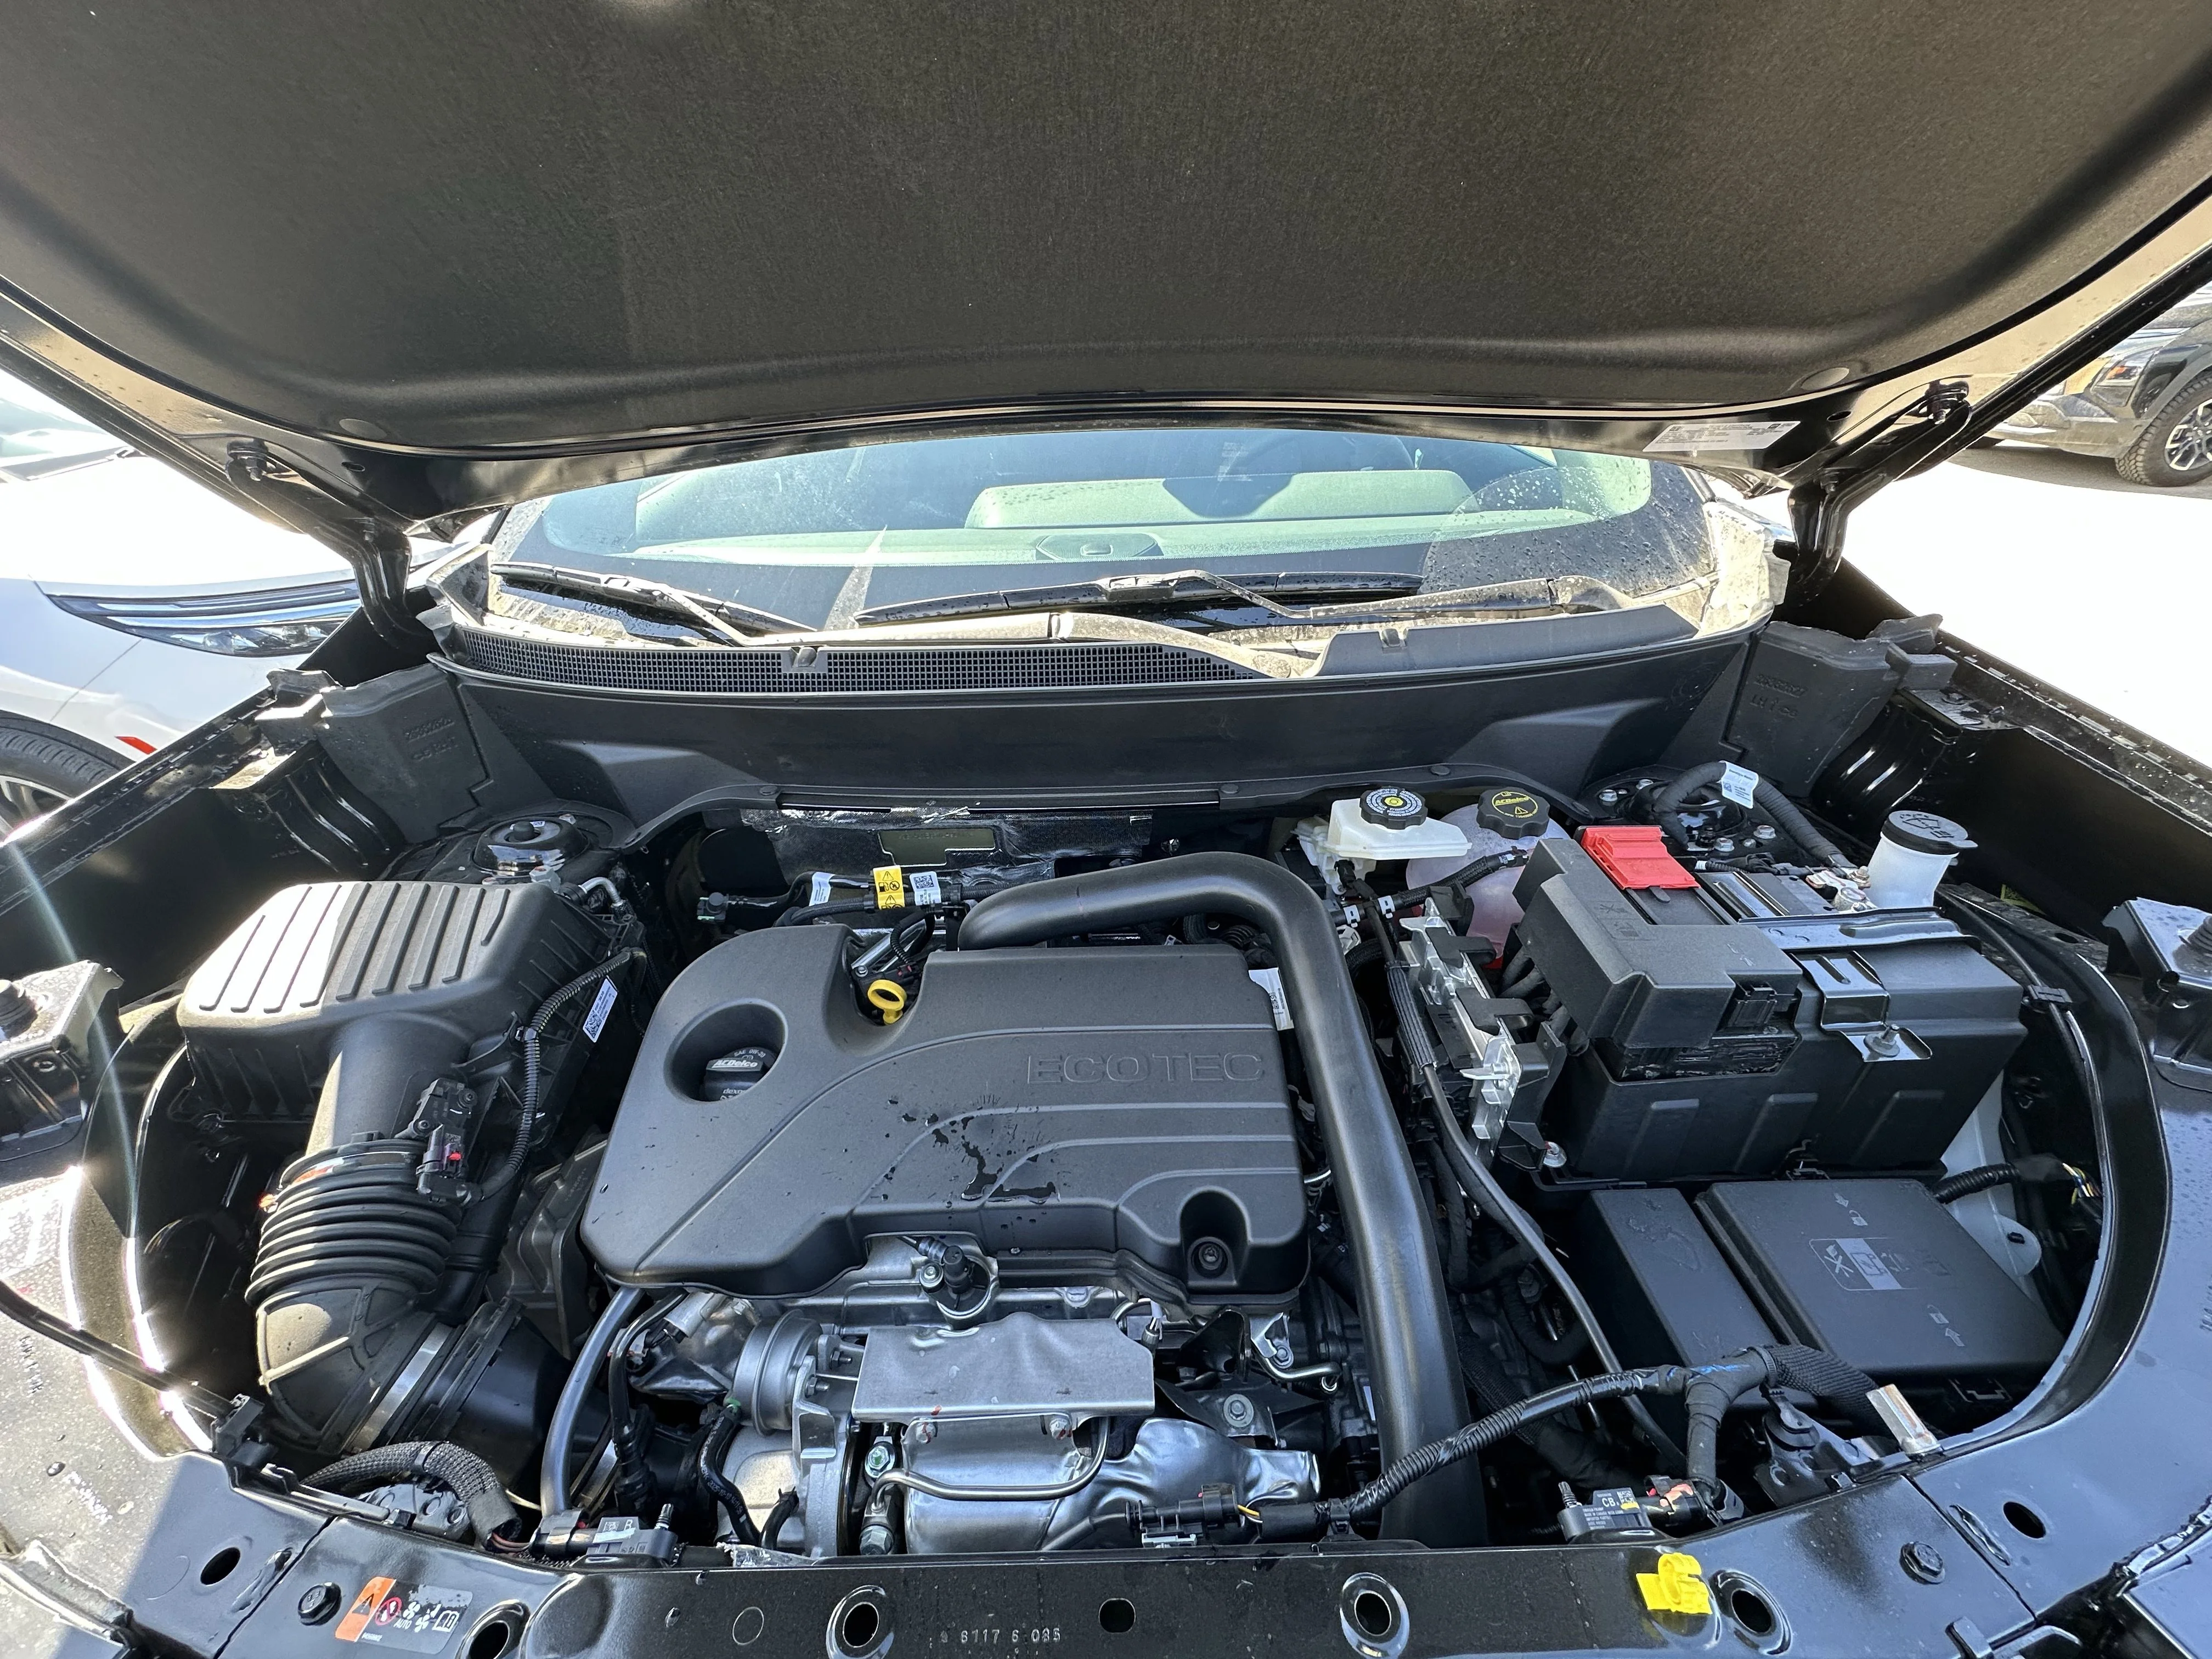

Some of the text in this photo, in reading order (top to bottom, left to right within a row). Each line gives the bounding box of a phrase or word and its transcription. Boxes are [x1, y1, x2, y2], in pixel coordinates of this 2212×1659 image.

[1495, 797, 1530, 806] ACDelco
[712, 1059, 758, 1068] ACDelco
[1027, 1052, 1263, 1085] ECOTEC
[393, 1619, 413, 1629] AUTO
[1012, 1629, 1019, 1643] 6
